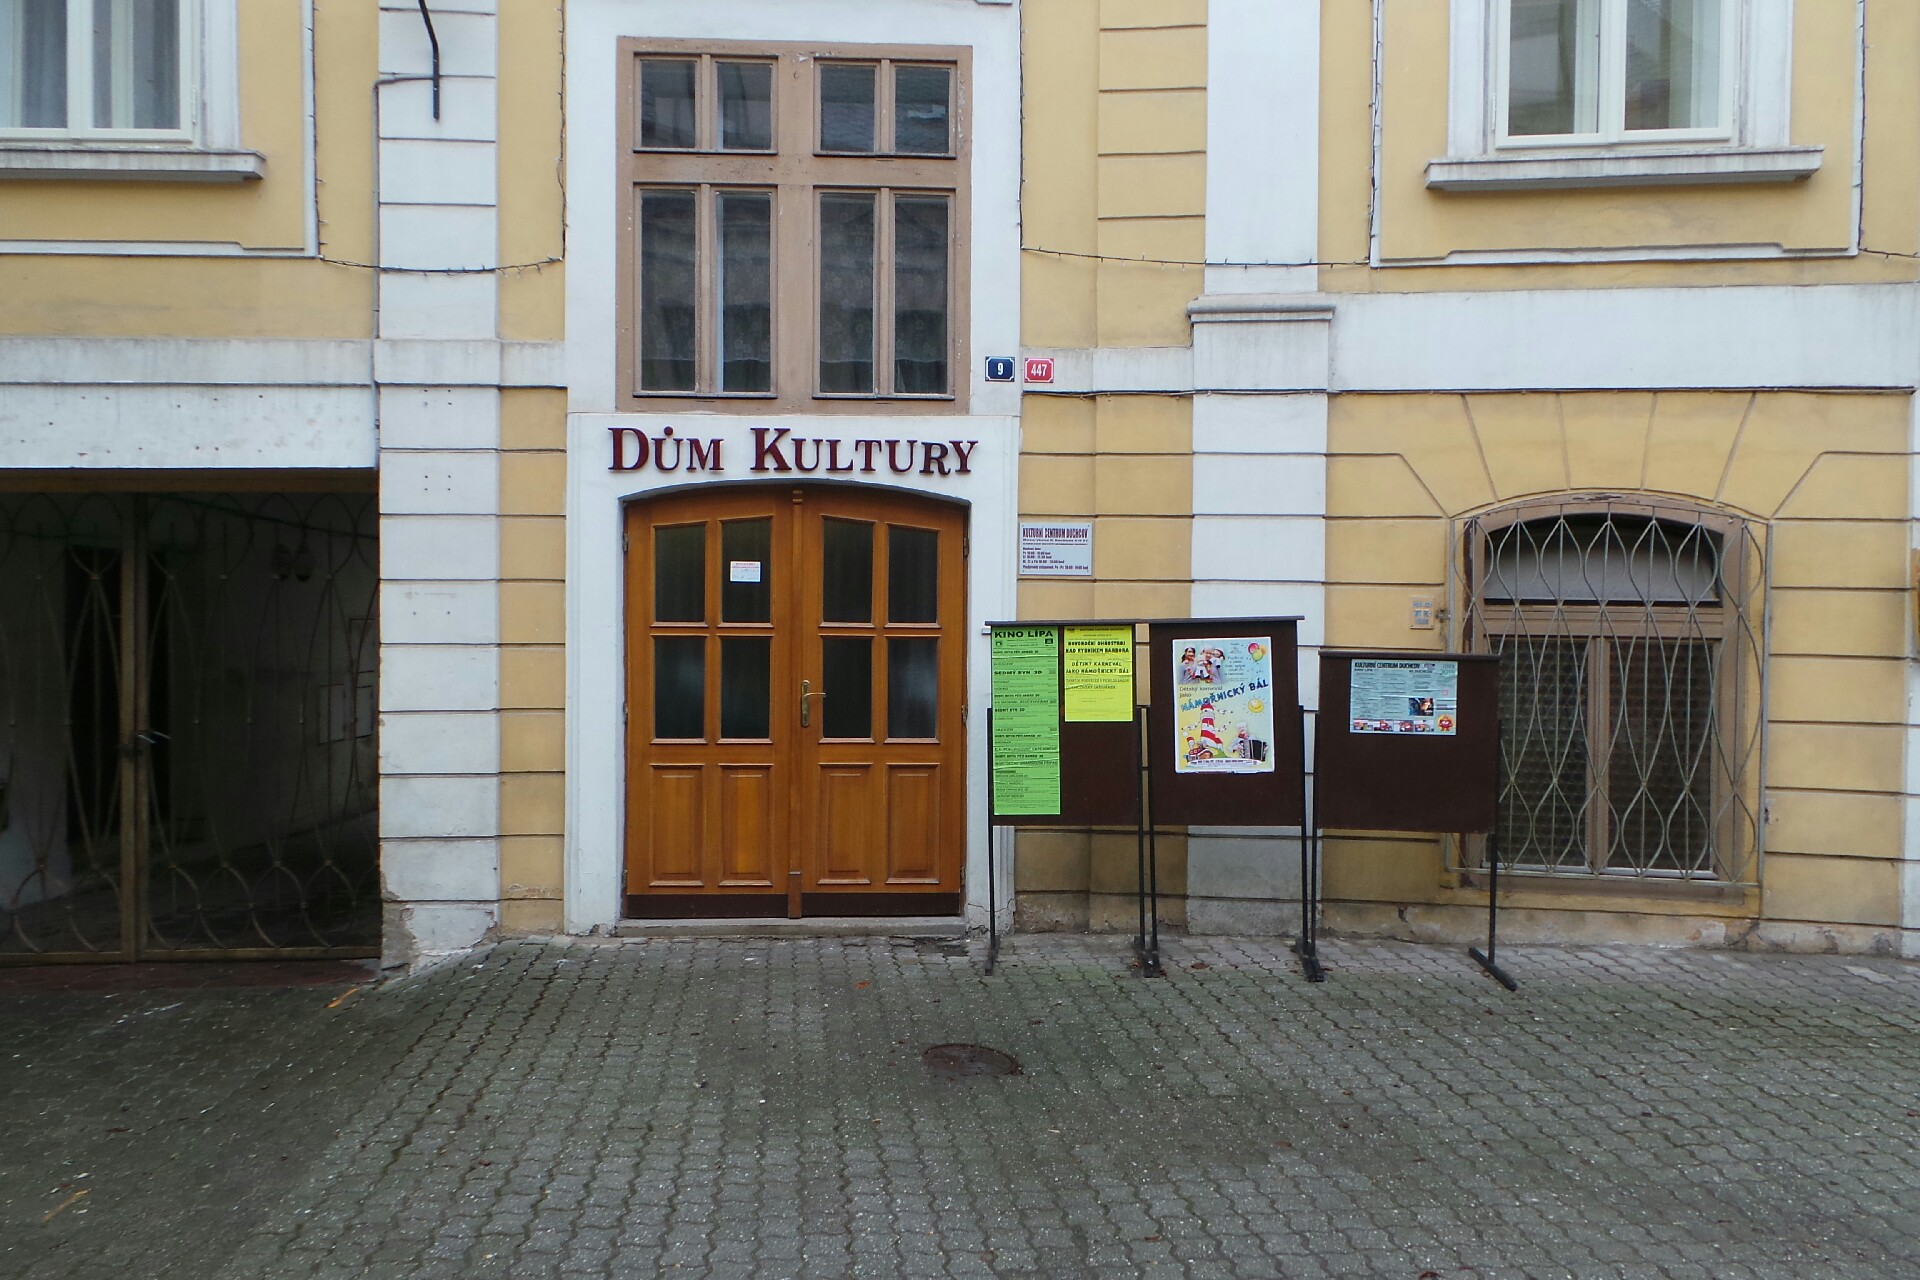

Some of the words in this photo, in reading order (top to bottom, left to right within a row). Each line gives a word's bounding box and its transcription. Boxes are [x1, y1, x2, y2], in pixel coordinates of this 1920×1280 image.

[997, 362, 1004, 376] 9
[1031, 363, 1048, 377] 447
[607, 425, 724, 472] DŮM
[750, 427, 979, 475] KULTURY
[1044, 527, 1066, 539] CENTRUM
[1066, 528, 1088, 539] DUCHCOV
[994, 631, 1024, 639] KINO
[1027, 629, 1054, 638] LÍPA
[1180, 682, 1246, 712] NÁMOŘNICKÝ
[1248, 677, 1270, 692] BÁL
